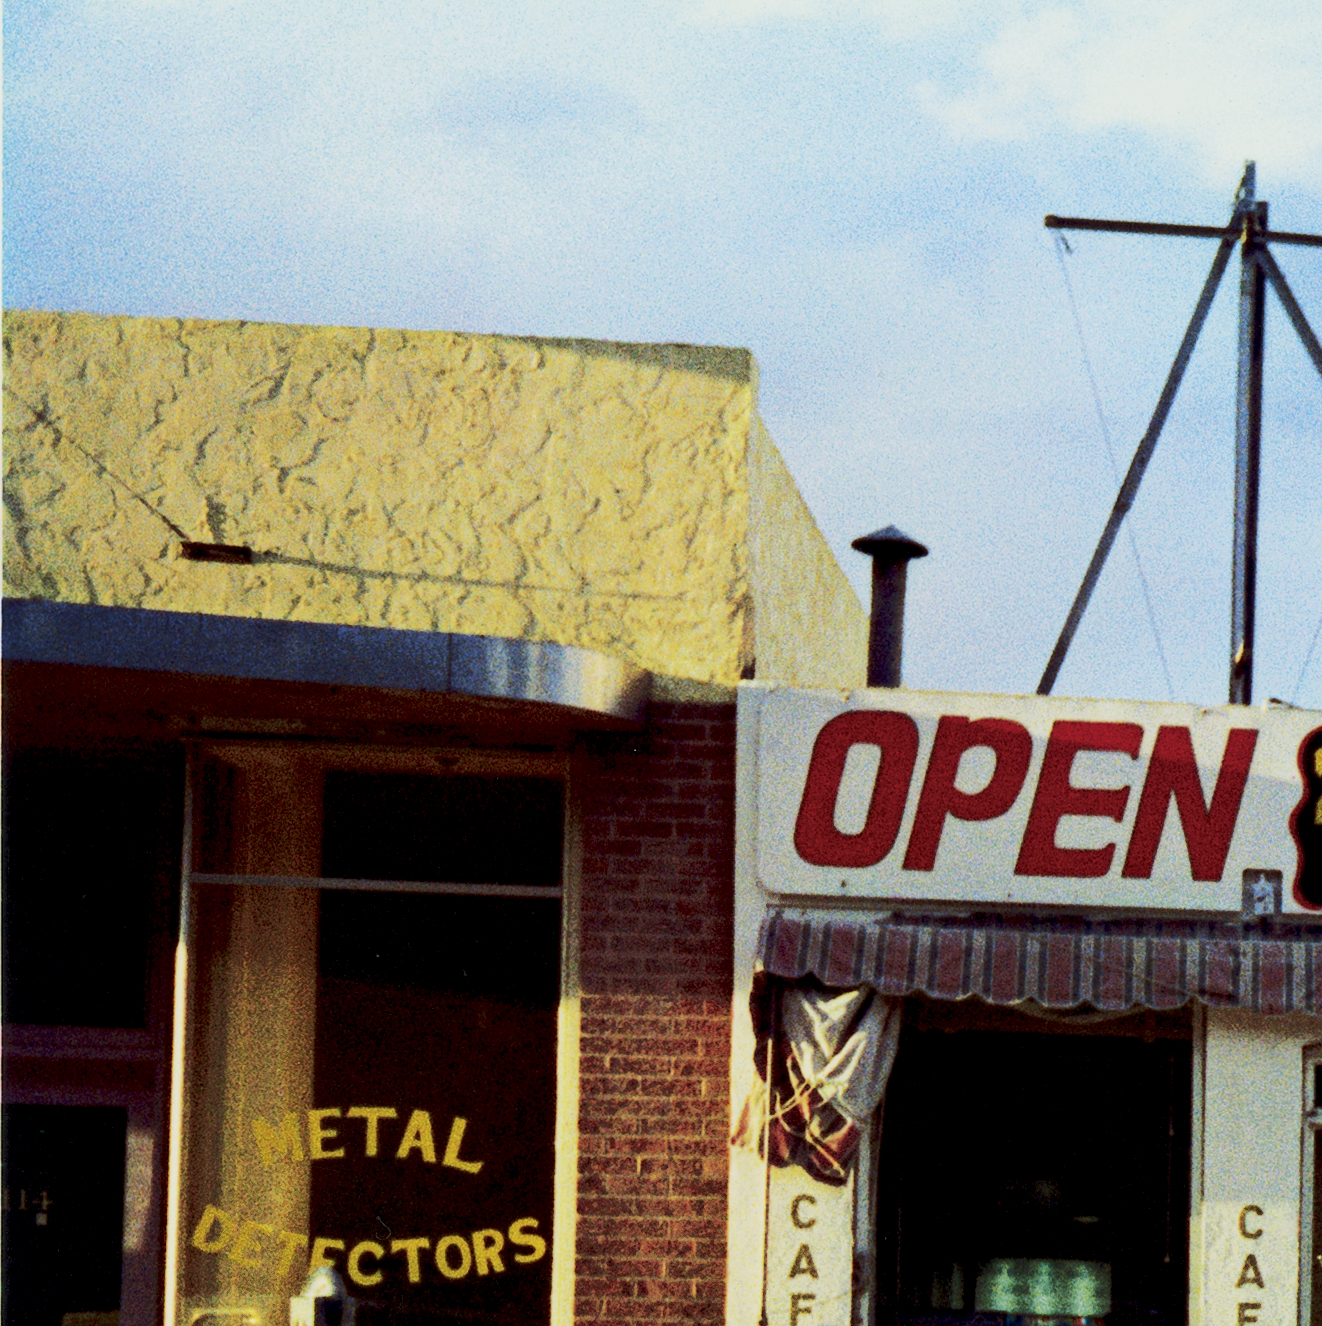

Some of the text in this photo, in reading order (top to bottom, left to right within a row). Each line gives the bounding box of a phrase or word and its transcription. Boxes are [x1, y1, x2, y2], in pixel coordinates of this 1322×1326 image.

[793, 709, 1259, 883] OPEN
[252, 1106, 484, 1174] METAL
[193, 1203, 546, 1286] DETECTORS
